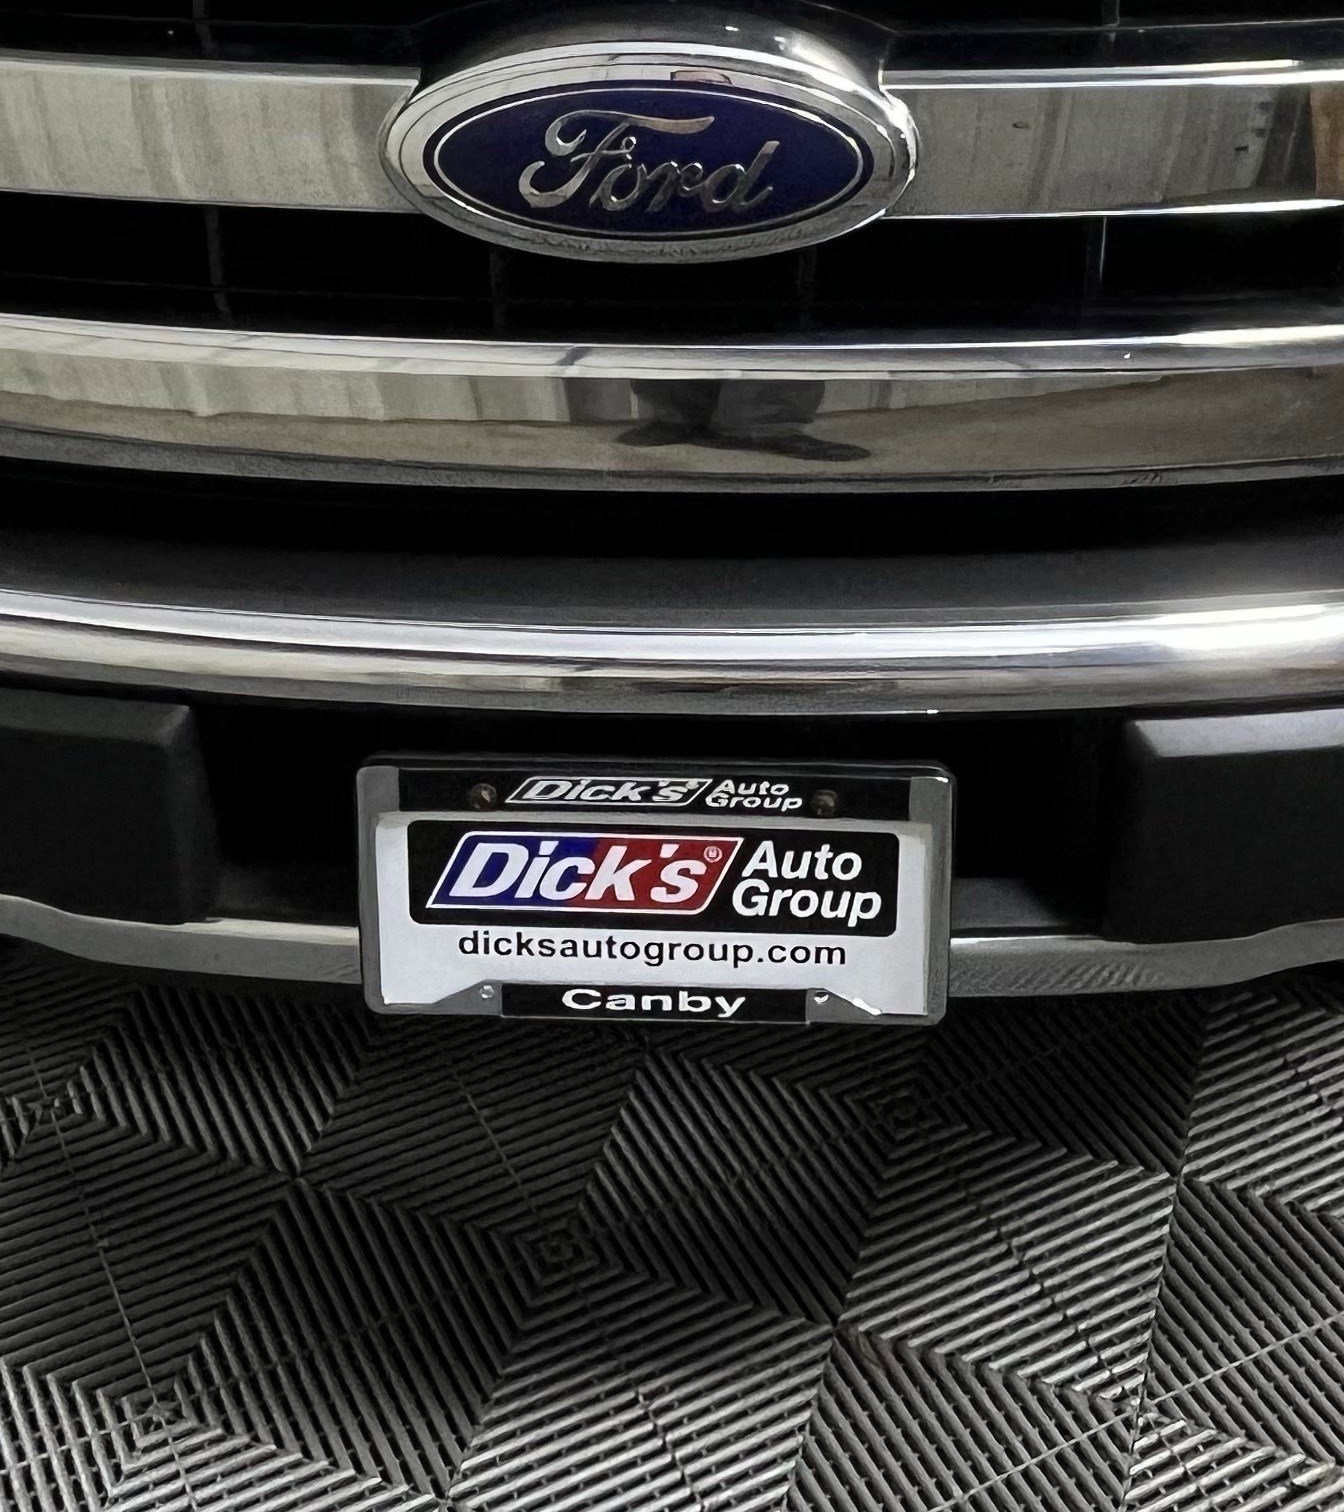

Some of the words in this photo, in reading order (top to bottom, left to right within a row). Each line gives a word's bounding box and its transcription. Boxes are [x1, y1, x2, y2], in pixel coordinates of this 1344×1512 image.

[518, 109, 780, 213] Ford
[521, 779, 692, 803] Dick's
[705, 792, 803, 811] Group
[713, 778, 790, 796] Auto
[448, 838, 708, 903] Dick's
[742, 839, 863, 881] Auto
[732, 878, 882, 928] Group
[458, 929, 847, 969] dicksautogroup.com
[561, 987, 746, 1017] Canby
